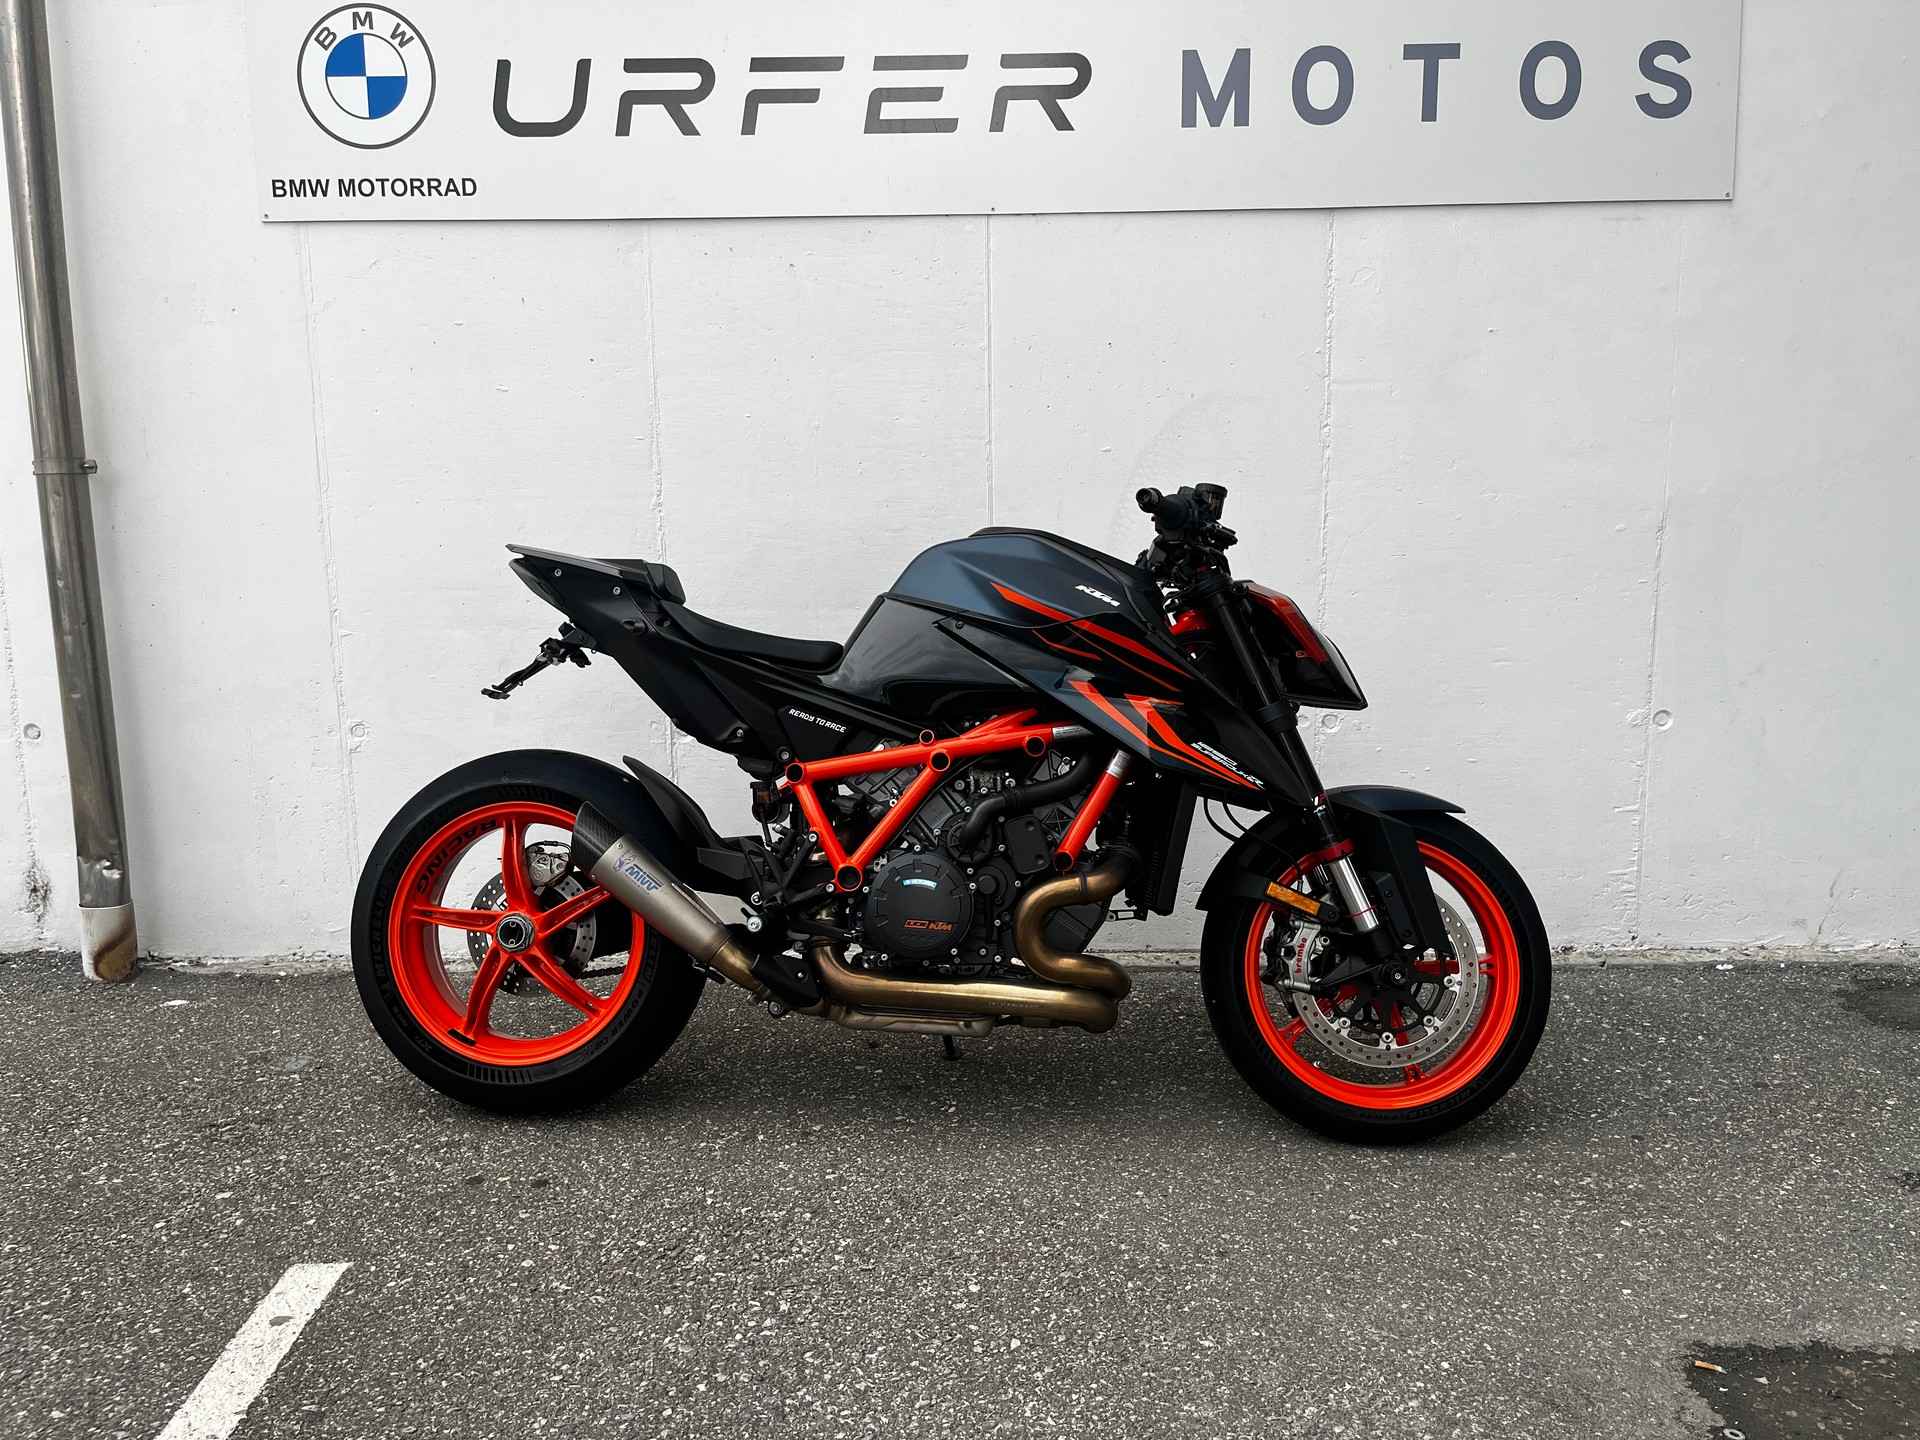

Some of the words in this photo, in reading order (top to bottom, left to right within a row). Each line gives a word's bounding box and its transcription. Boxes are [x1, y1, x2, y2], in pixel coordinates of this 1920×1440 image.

[313, 10, 414, 52] BMW
[492, 52, 1092, 137] URFER
[1181, 40, 1692, 128] MOTOS
[271, 178, 331, 198] BMW
[337, 177, 478, 198] MOTORRAD
[1075, 583, 1121, 607] KTM
[788, 708, 815, 722] READY
[815, 717, 826, 726] TO
[824, 721, 847, 733] RACE
[417, 818, 497, 894] RACING
[370, 884, 390, 978] MICHELIN
[1294, 937, 1308, 974] brembo
[611, 988, 643, 1037] POWER
